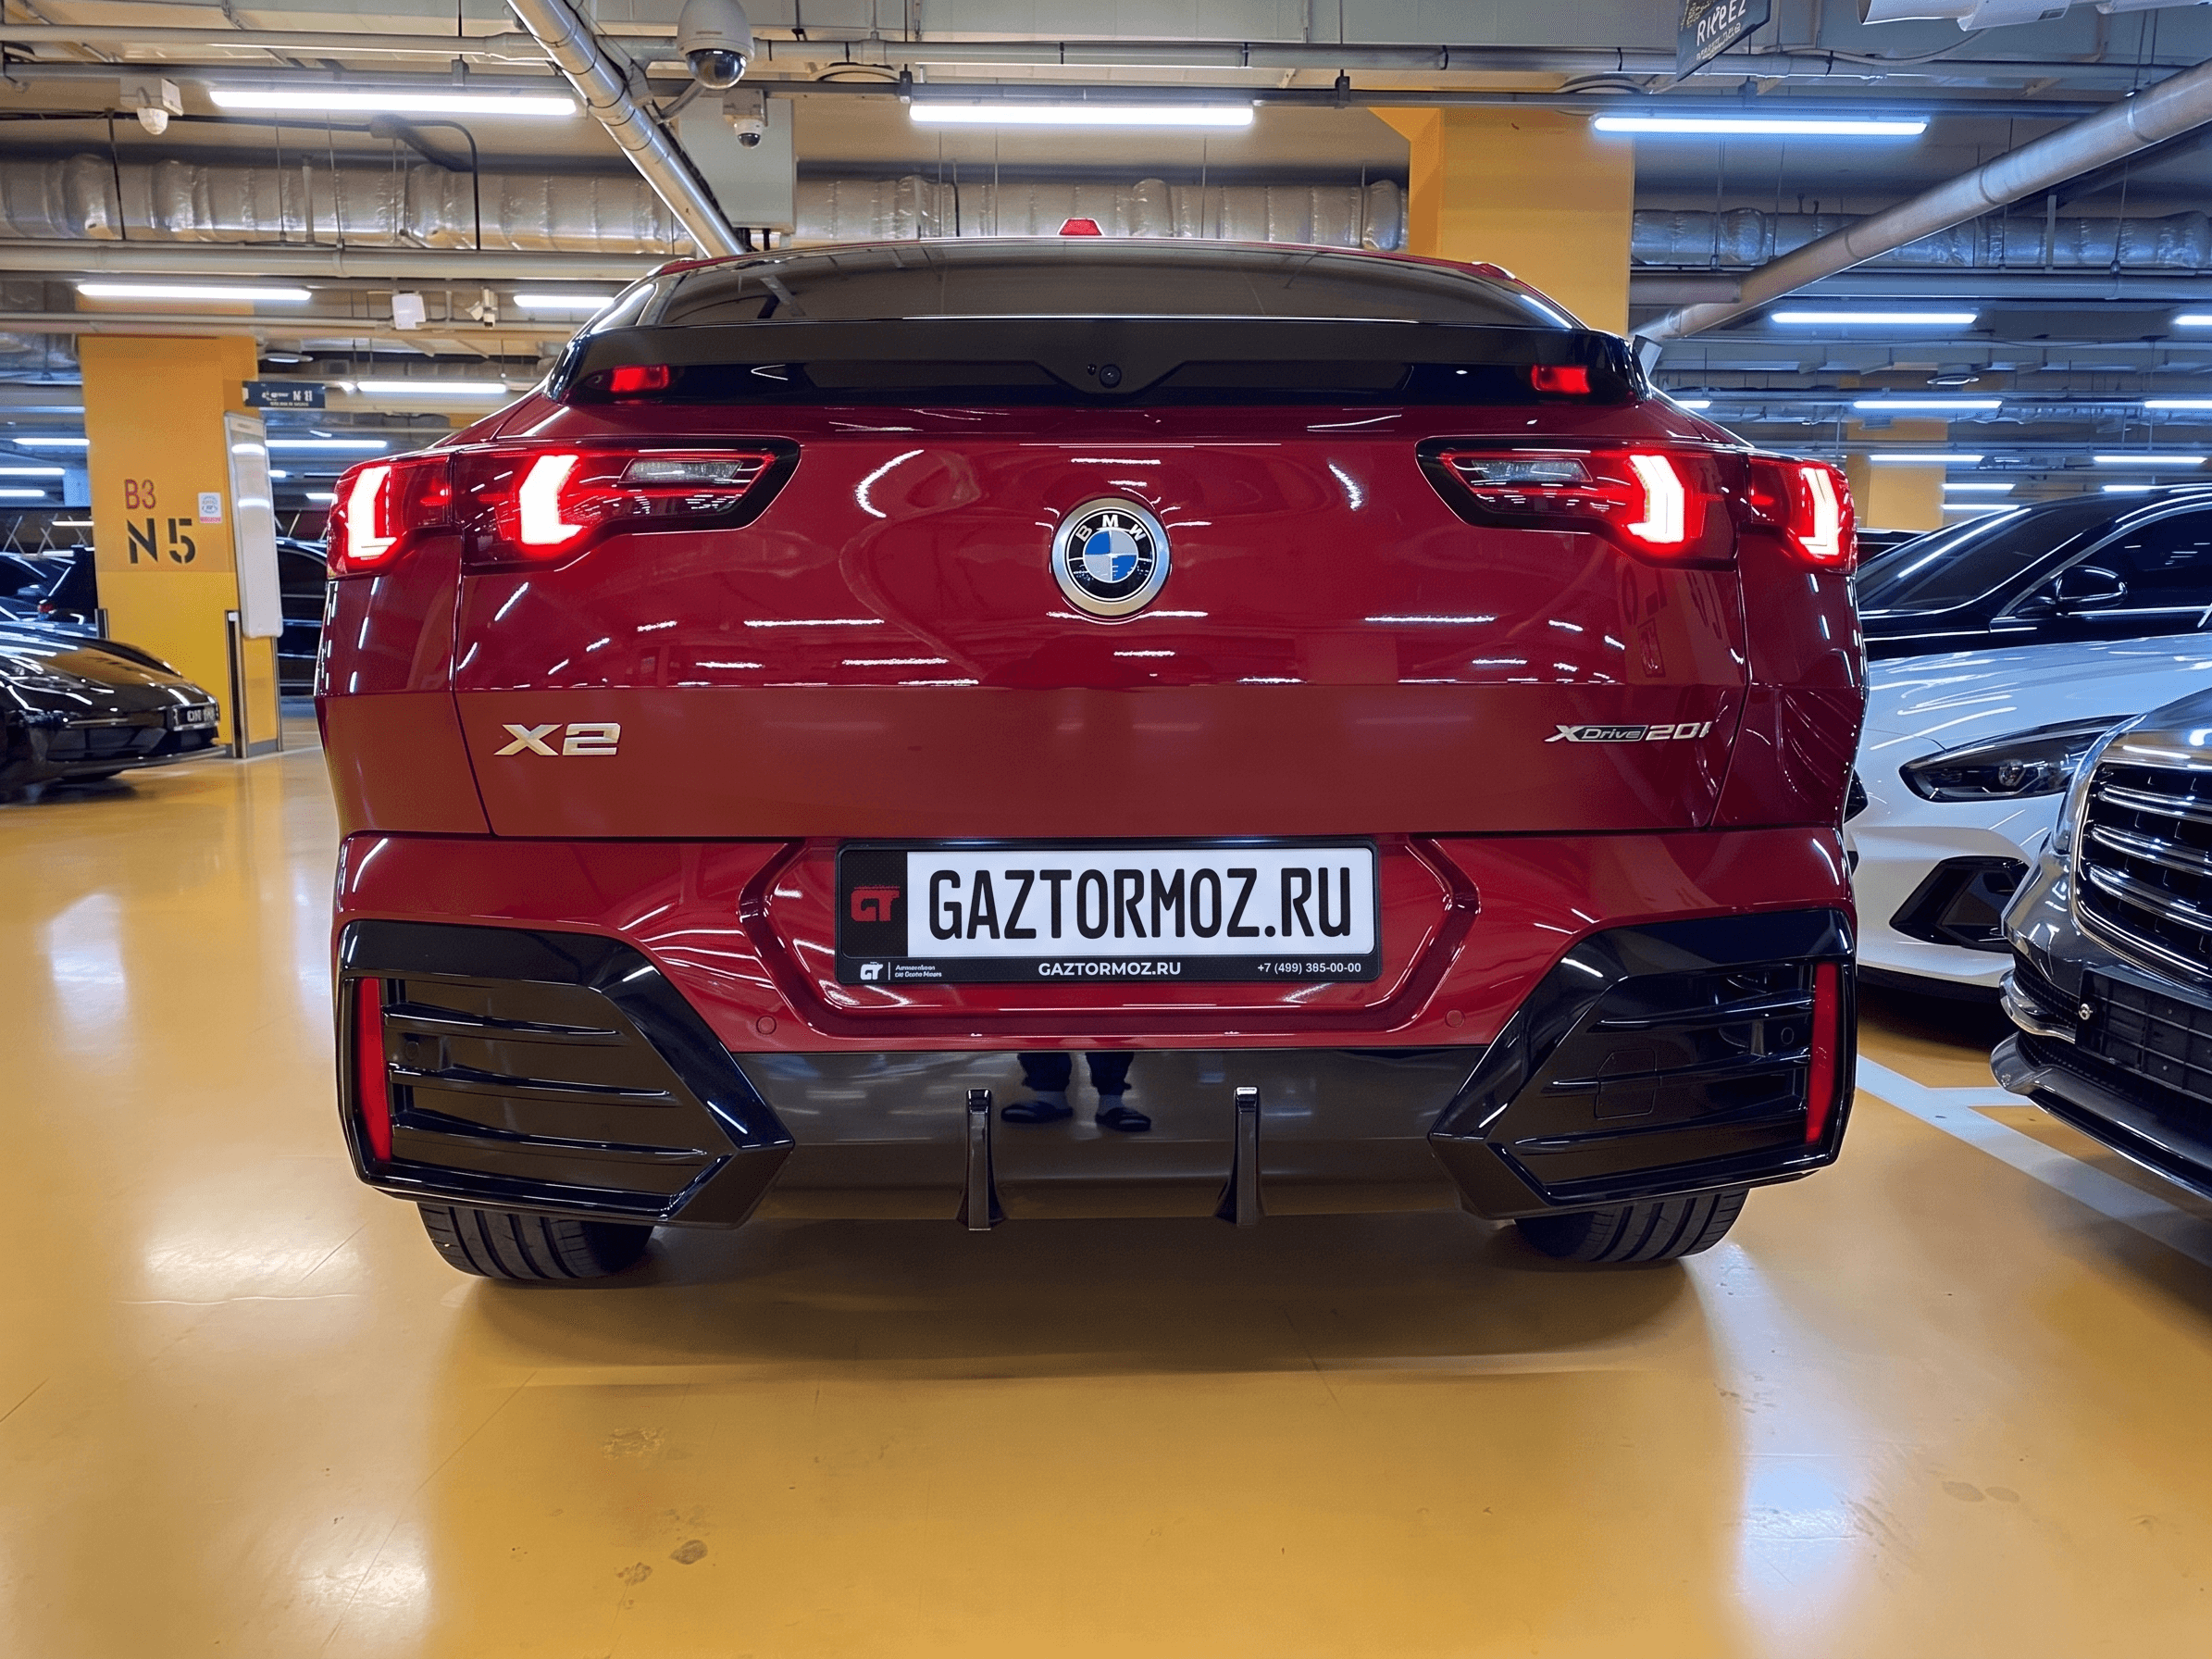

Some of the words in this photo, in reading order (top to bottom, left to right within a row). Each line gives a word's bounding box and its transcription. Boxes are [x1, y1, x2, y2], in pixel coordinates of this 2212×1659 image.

[125, 479, 155, 509] B3
[127, 518, 158, 564] N
[168, 518, 195, 564] 5
[1075, 515, 1147, 543] BMW
[493, 723, 621, 755] X2
[929, 867, 1351, 941] GAZTORMOZ.RU
[1038, 962, 1182, 977] GAZTORMOZ.RU
[1258, 963, 1271, 973] +7
[1274, 963, 1302, 975] (499)
